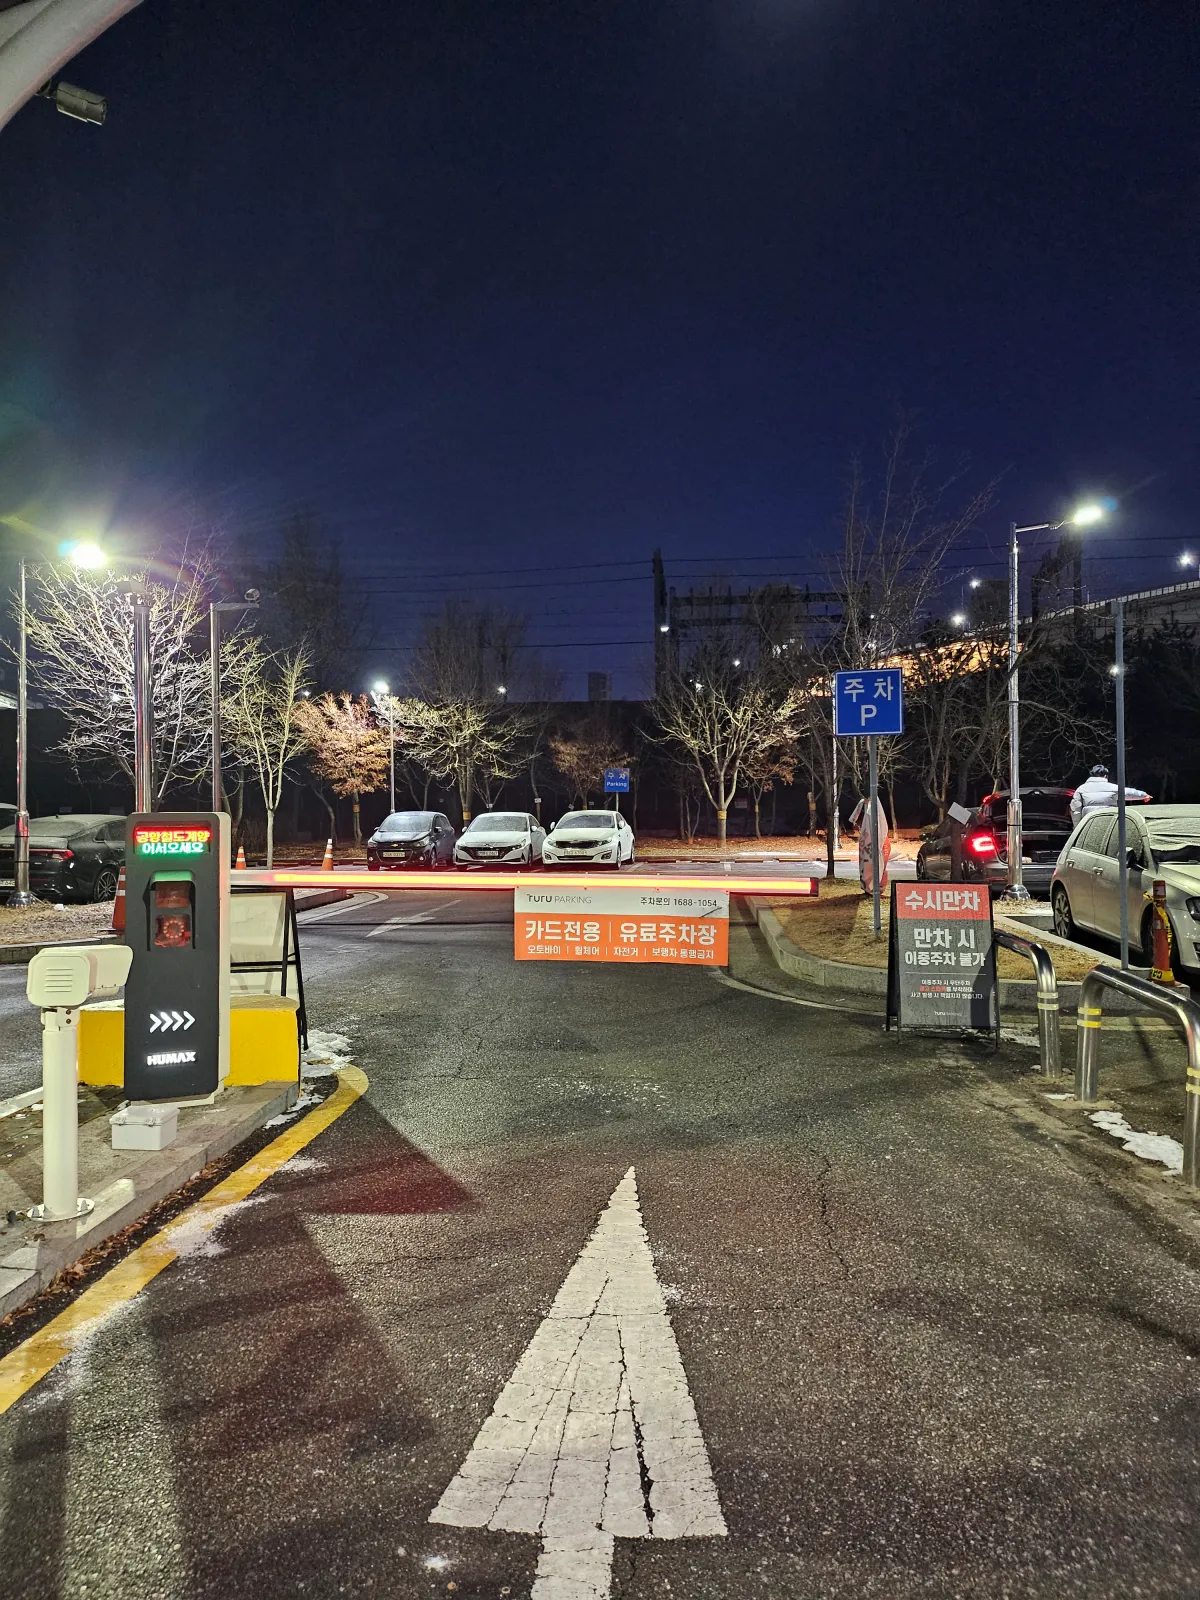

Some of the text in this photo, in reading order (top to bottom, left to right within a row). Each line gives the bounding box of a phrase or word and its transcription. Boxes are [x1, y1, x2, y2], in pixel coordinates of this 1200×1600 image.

[860, 704, 877, 727] P
[141, 842, 204, 854] 어서오세요
[554, 895, 592, 904] PARKING
[640, 896, 717, 907] 주차문의 1688-1054
[905, 890, 981, 911] 수시만차
[525, 920, 717, 945] 카드전용 유료주차장
[913, 928, 975, 949] 만차 시
[527, 944, 714, 960] 오토바이 휠체어 자전거 보행자 통행금지
[904, 951, 986, 967] 이중주차 불가
[147, 1051, 196, 1066] HUMAX
